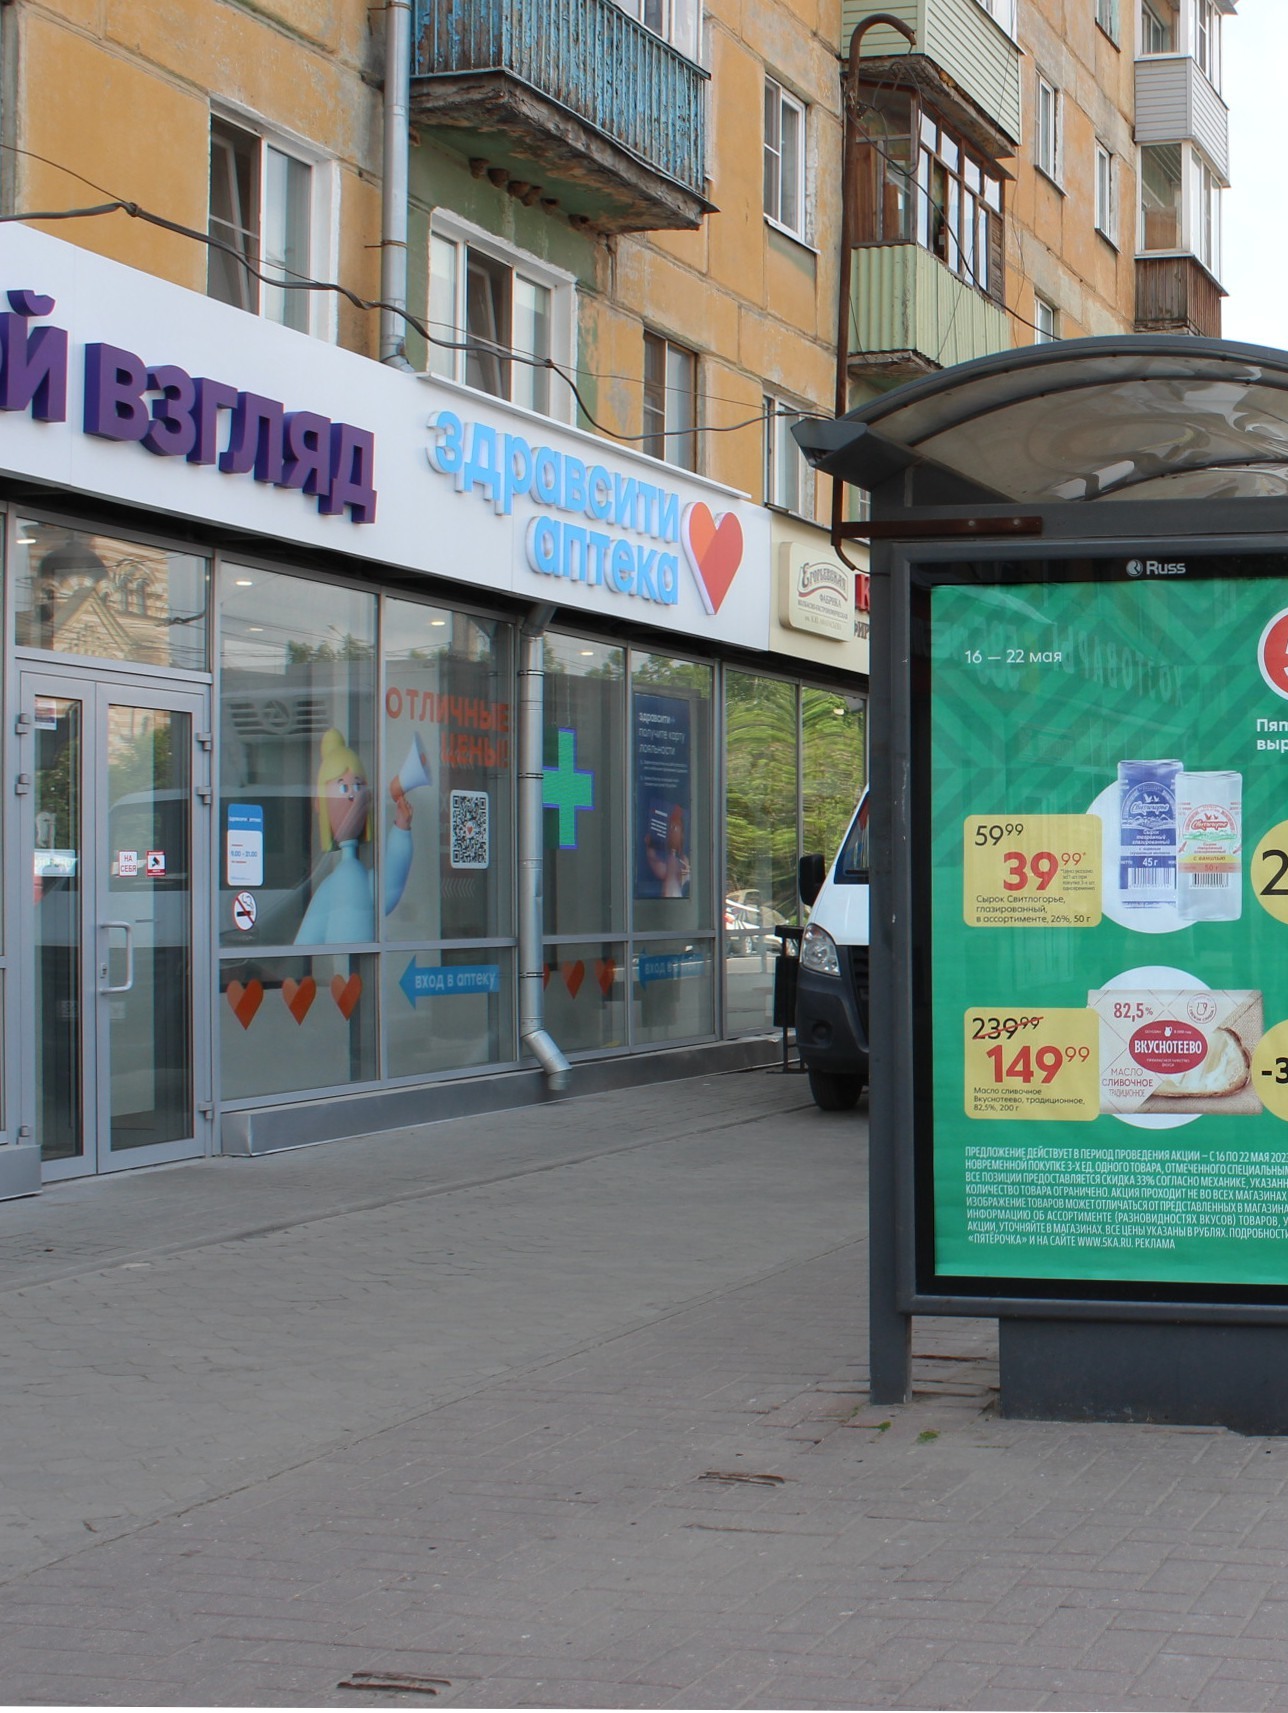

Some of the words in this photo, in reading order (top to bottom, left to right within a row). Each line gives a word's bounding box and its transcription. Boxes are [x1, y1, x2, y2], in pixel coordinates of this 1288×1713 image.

[0, 290, 68, 423] Й
[84, 342, 378, 524] ВЗГЛЯД
[427, 410, 679, 543] здравсити
[526, 515, 678, 605] аптека
[1146, 560, 1186, 575] Russ
[964, 650, 982, 664] 16
[1006, 649, 1025, 664] 22
[1029, 649, 1062, 663] мая
[386, 687, 509, 732] ОТЛИЧНЫЕ
[441, 731, 508, 769] ЦЕНЫ!
[120, 865, 137, 873] СЕБЯ
[1142, 858, 1153, 867] 45
[976, 895, 1005, 905] Сырок
[1007, 895, 1066, 905] Свитлогорье,
[976, 905, 1048, 915] глазированный,
[983, 916, 1049, 924] ассортименте,
[415, 973, 445, 991] вход
[447, 976, 454, 987] в
[457, 971, 496, 991] аптеку
[1113, 1002, 1153, 1022] 82,5%
[1134, 1039, 1203, 1055] ВКУСНОТЕЕВО
[1111, 1067, 1143, 1077] МАСЛО
[974, 1087, 999, 1095] Масло
[1102, 1078, 1153, 1087] СЛИВОЧНОЕ
[974, 1095, 1024, 1104] Вкуснотеево,
[1025, 1097, 1085, 1105] традиционное,
[1109, 1088, 1146, 1098] ТРАДИЦИОННОЕ
[965, 1146, 1026, 1160] ПРЕДЛОЖЕНИЕ
[1027, 1146, 1072, 1161] ДЕЙСТВУЕТ
[1073, 1148, 1079, 1159] В
[1080, 1149, 1114, 1162] ПЕРИОД
[1114, 1149, 1171, 1163] ПРОВЕДЕНИЯ
[1171, 1150, 1200, 1164] АКЦИИ
[1209, 1151, 1215, 1162] С
[1216, 1151, 1225, 1162] 16
[1225, 1151, 1238, 1163] ПО
[1239, 1152, 1249, 1163] 22
[1250, 1152, 1270, 1163] МАЯ
[965, 1157, 1027, 1171] НОВРЕМЕННОЙ
[1028, 1160, 1065, 1172] ПОКУПКЕ
[1067, 1161, 1081, 1172] 3-Х
[1081, 1161, 1094, 1174] ЕД.
[1095, 1162, 1129, 1175] ОДНОГО
[1130, 1162, 1164, 1176] ТОВАРА,
[1165, 1163, 1226, 1175] ОТМЕЧЕННОГО
[965, 1172, 981, 1183] ВСЕ
[982, 1172, 1022, 1186] ПОЗИЦИИ
[1023, 1173, 1101, 1187] ПРЕДОСТАВЛЯЕТСЯ
[1101, 1175, 1135, 1188] СКИДКА
[1136, 1175, 1155, 1186] 33%
[1156, 1176, 1199, 1187] СОГЛАСНО
[1200, 1177, 1249, 1190] МЕХАНИКЕ,
[965, 1184, 1019, 1196] КОЛИЧЕСТВО
[1020, 1186, 1052, 1197] ТОВАРА
[1053, 1186, 1110, 1198] ОГРАНИЧЕНО.
[1110, 1187, 1140, 1201] АКЦИЯ
[1141, 1188, 1186, 1201] ПРОХОДИТ
[1187, 1189, 1198, 1200] НЕ
[1199, 1189, 1212, 1200] ВО
[1213, 1189, 1234, 1201] ВСЕХ
[1235, 1190, 1287, 1202] МАГАЗИНАХ
[966, 1197, 1026, 1209] ИЗОБРАЖЕНИЕ
[1027, 1198, 1064, 1210] ТОВАРОВ
[1065, 1199, 1095, 1210] МОЖЕТ
[1095, 1199, 1148, 1211] ОТЛИЧАТЬСЯ
[1148, 1200, 1159, 1211] ОТ
[1160, 1201, 1236, 1215] ПРЕДСТАВЛЕННЫХ
[1237, 1202, 1243, 1213] В
[967, 1209, 1031, 1223] ИНФОРМАЦИЮ
[1033, 1211, 1045, 1222] ОБ
[1047, 1211, 1113, 1223] АССОРТИМЕНТЕ
[1114, 1212, 1197, 1226] (РАЗНОВИДНОСТЯХ
[1200, 1214, 1236, 1225] ВКУСОВ)
[1239, 1215, 1281, 1228] ТОВАРОВ,
[967, 1222, 998, 1235] АКЦИИ,
[999, 1220, 1045, 1234] УТОЧНЯЙТЕ
[1046, 1223, 1052, 1234] В
[1053, 1223, 1104, 1235] МАГАЗИНАХ.
[1105, 1224, 1120, 1235] ВСЕ
[1121, 1225, 1146, 1238] ЦЕНЫ
[1146, 1225, 1186, 1237] УКАЗАНЫ
[1187, 1226, 1193, 1237] В
[1194, 1226, 1228, 1238] РУБЛЯХ.
[968, 1232, 1027, 1246] «ПЯТЁРОЧКА»
[1029, 1235, 1036, 1246] И
[1037, 1235, 1049, 1246] НА
[1049, 1233, 1076, 1247] САЙТЕ
[1077, 1236, 1134, 1248] WWW.5KA.RU.
[1135, 1237, 1175, 1249] РЕКЛАМА
